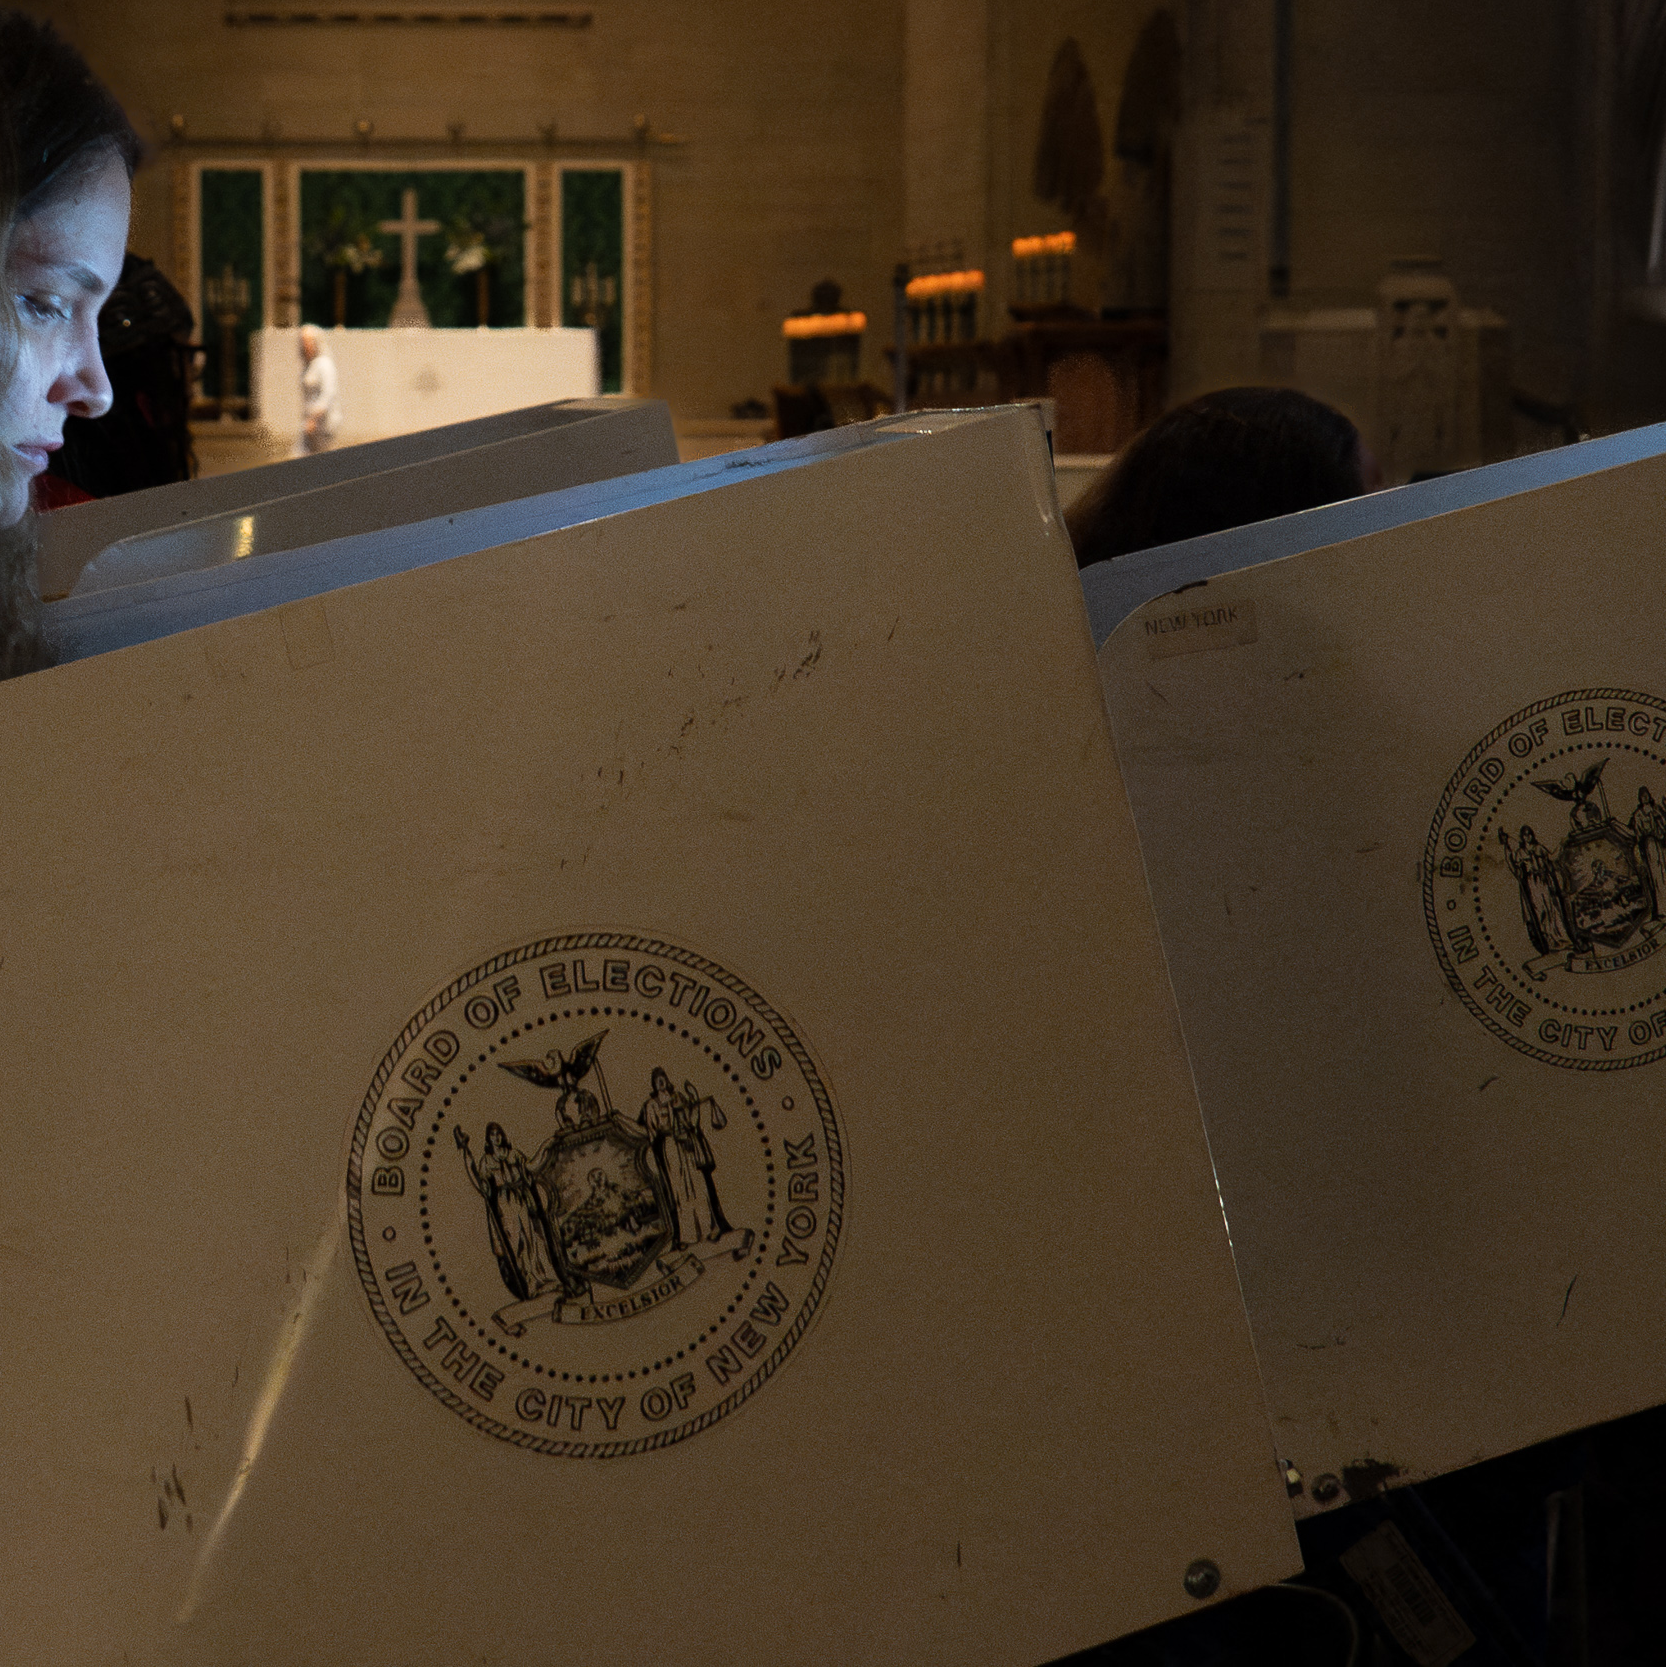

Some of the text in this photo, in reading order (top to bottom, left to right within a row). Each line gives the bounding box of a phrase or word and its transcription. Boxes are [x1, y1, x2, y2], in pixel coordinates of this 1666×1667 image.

[1440, 757, 1505, 877] BOARD
[1508, 719, 1549, 758] OF
[1447, 925, 1480, 965] IN
[1473, 966, 1532, 1028] THE
[1538, 1018, 1618, 1051] CITY
[1585, 938, 1662, 972] EXCELSIOR
[372, 959, 782, 1196] BOARD OF ELECTIONS
[385, 1134, 819, 1431] IN THE CITY OF NEW YORK
[580, 1274, 684, 1321] EXCELSIOR
